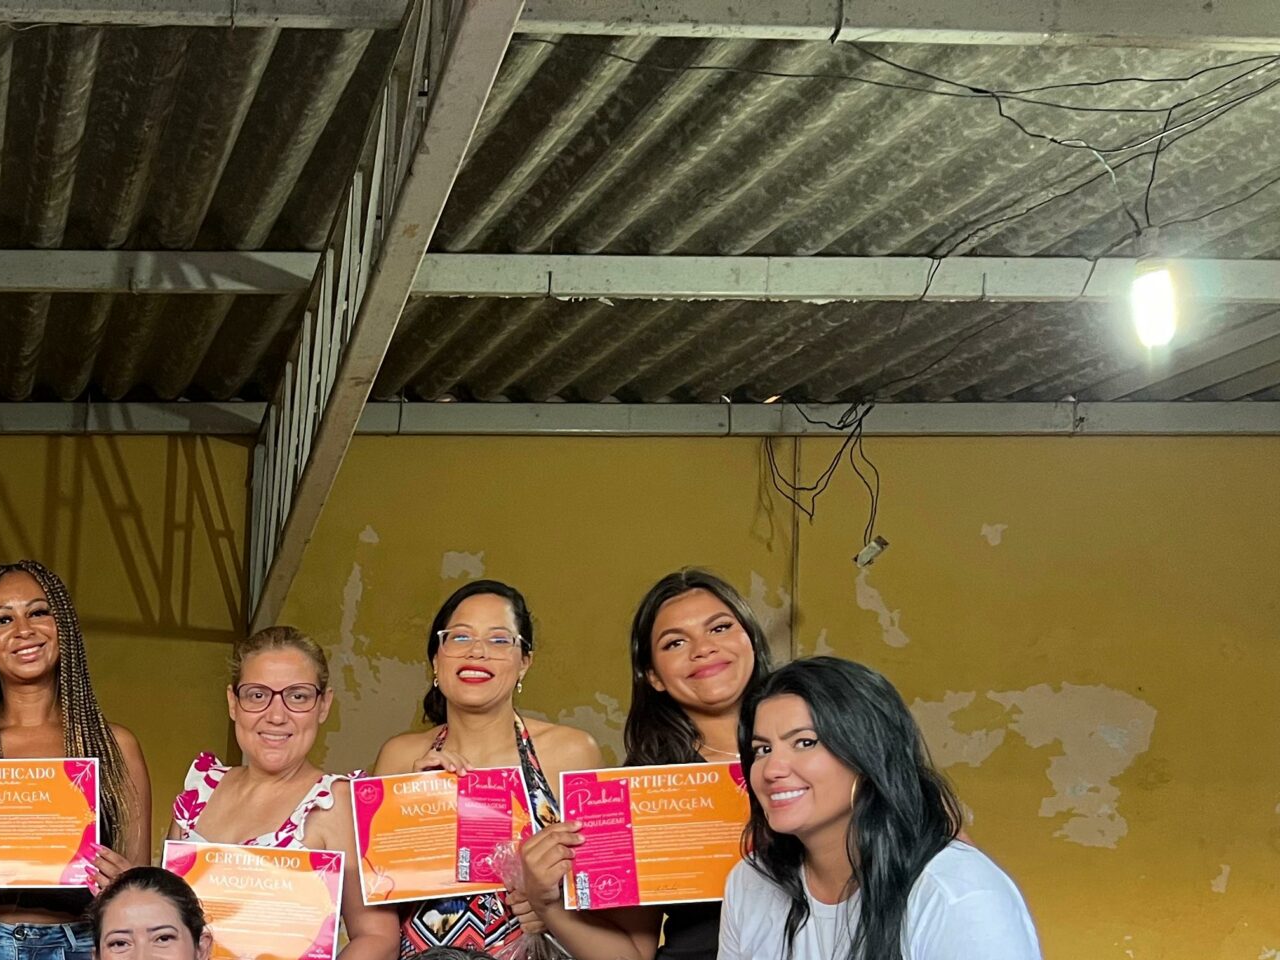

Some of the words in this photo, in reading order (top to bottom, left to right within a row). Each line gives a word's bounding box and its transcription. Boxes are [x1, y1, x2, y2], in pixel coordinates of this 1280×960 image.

[393, 776, 456, 796] CERTIFIC
[630, 771, 719, 789] RTIFICADO
[400, 800, 457, 817] MAQUIA
[630, 796, 714, 814] AQUIAGEM
[205, 851, 301, 869] CERTIFICADO
[208, 874, 293, 891] MAQUIAGEM
